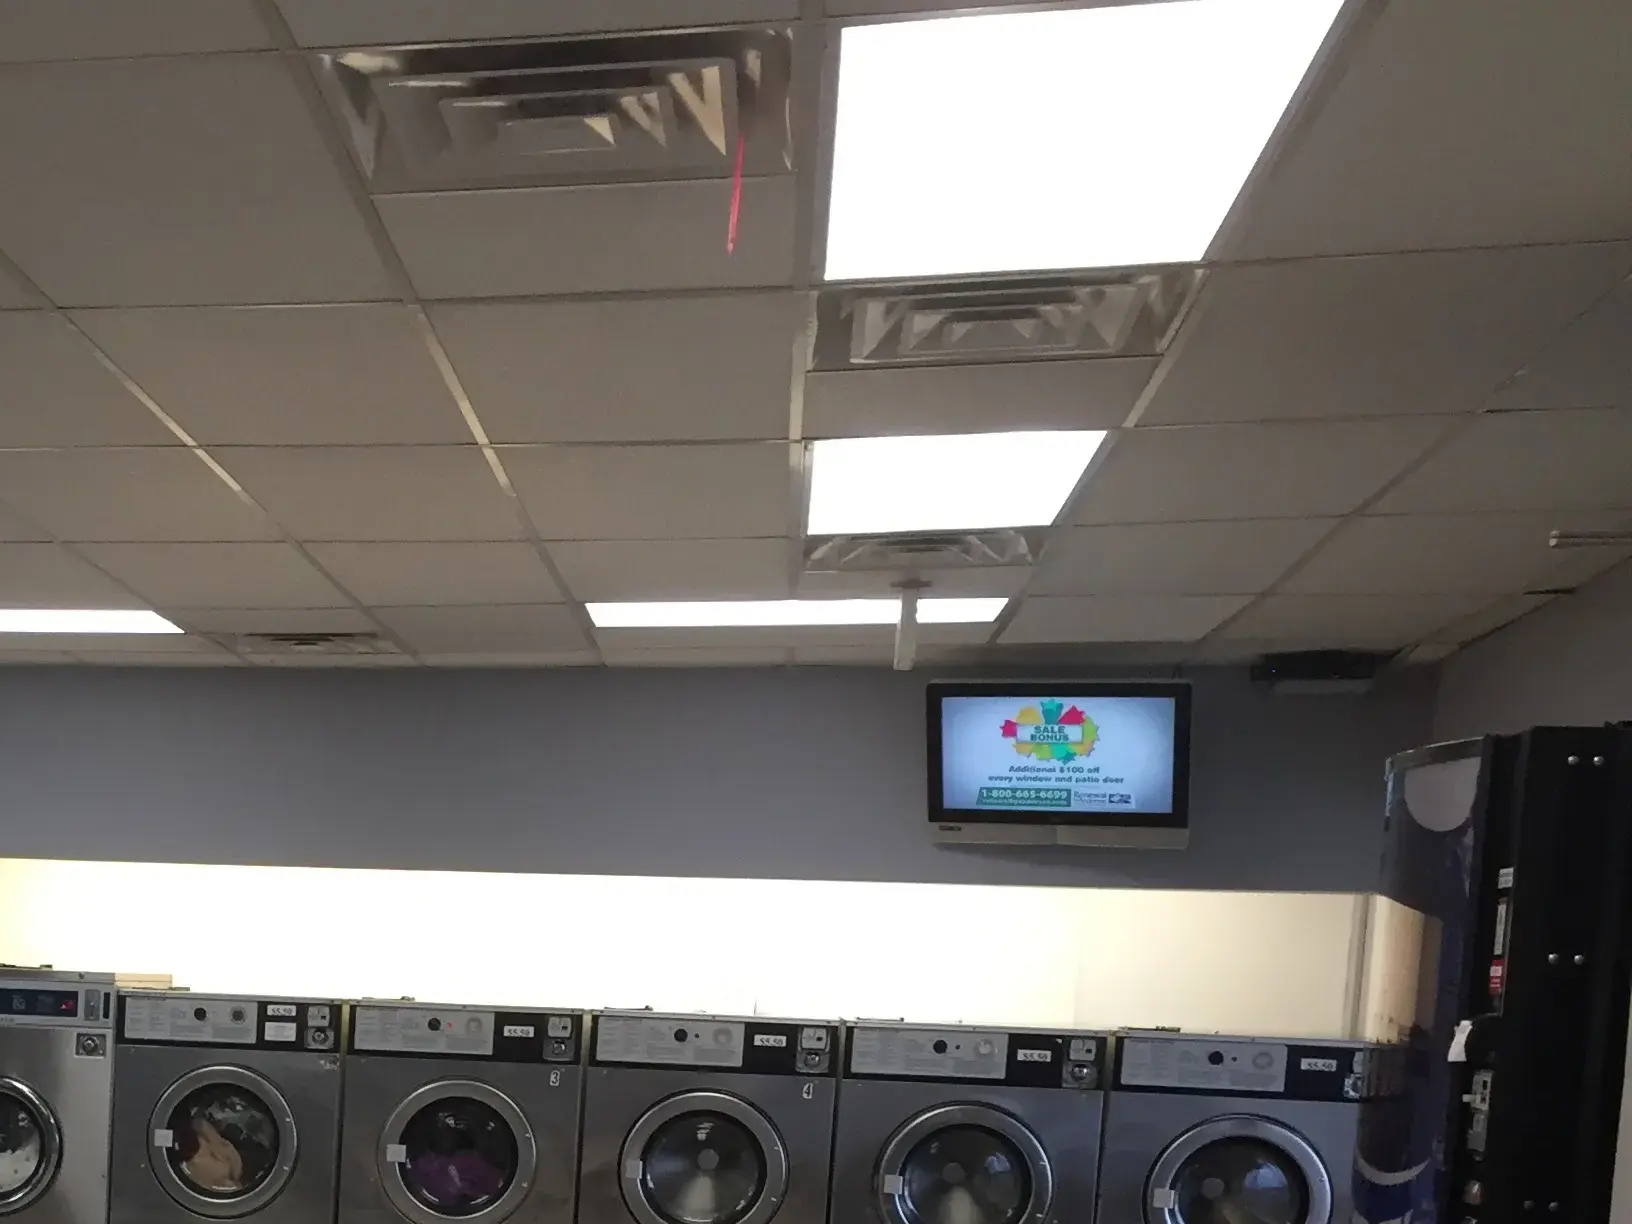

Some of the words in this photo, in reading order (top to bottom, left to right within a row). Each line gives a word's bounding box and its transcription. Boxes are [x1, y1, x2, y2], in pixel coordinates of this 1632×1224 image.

[1034, 725, 1066, 734] SALE
[1008, 765, 1057, 773] Additional
[552, 1071, 559, 1084] 3
